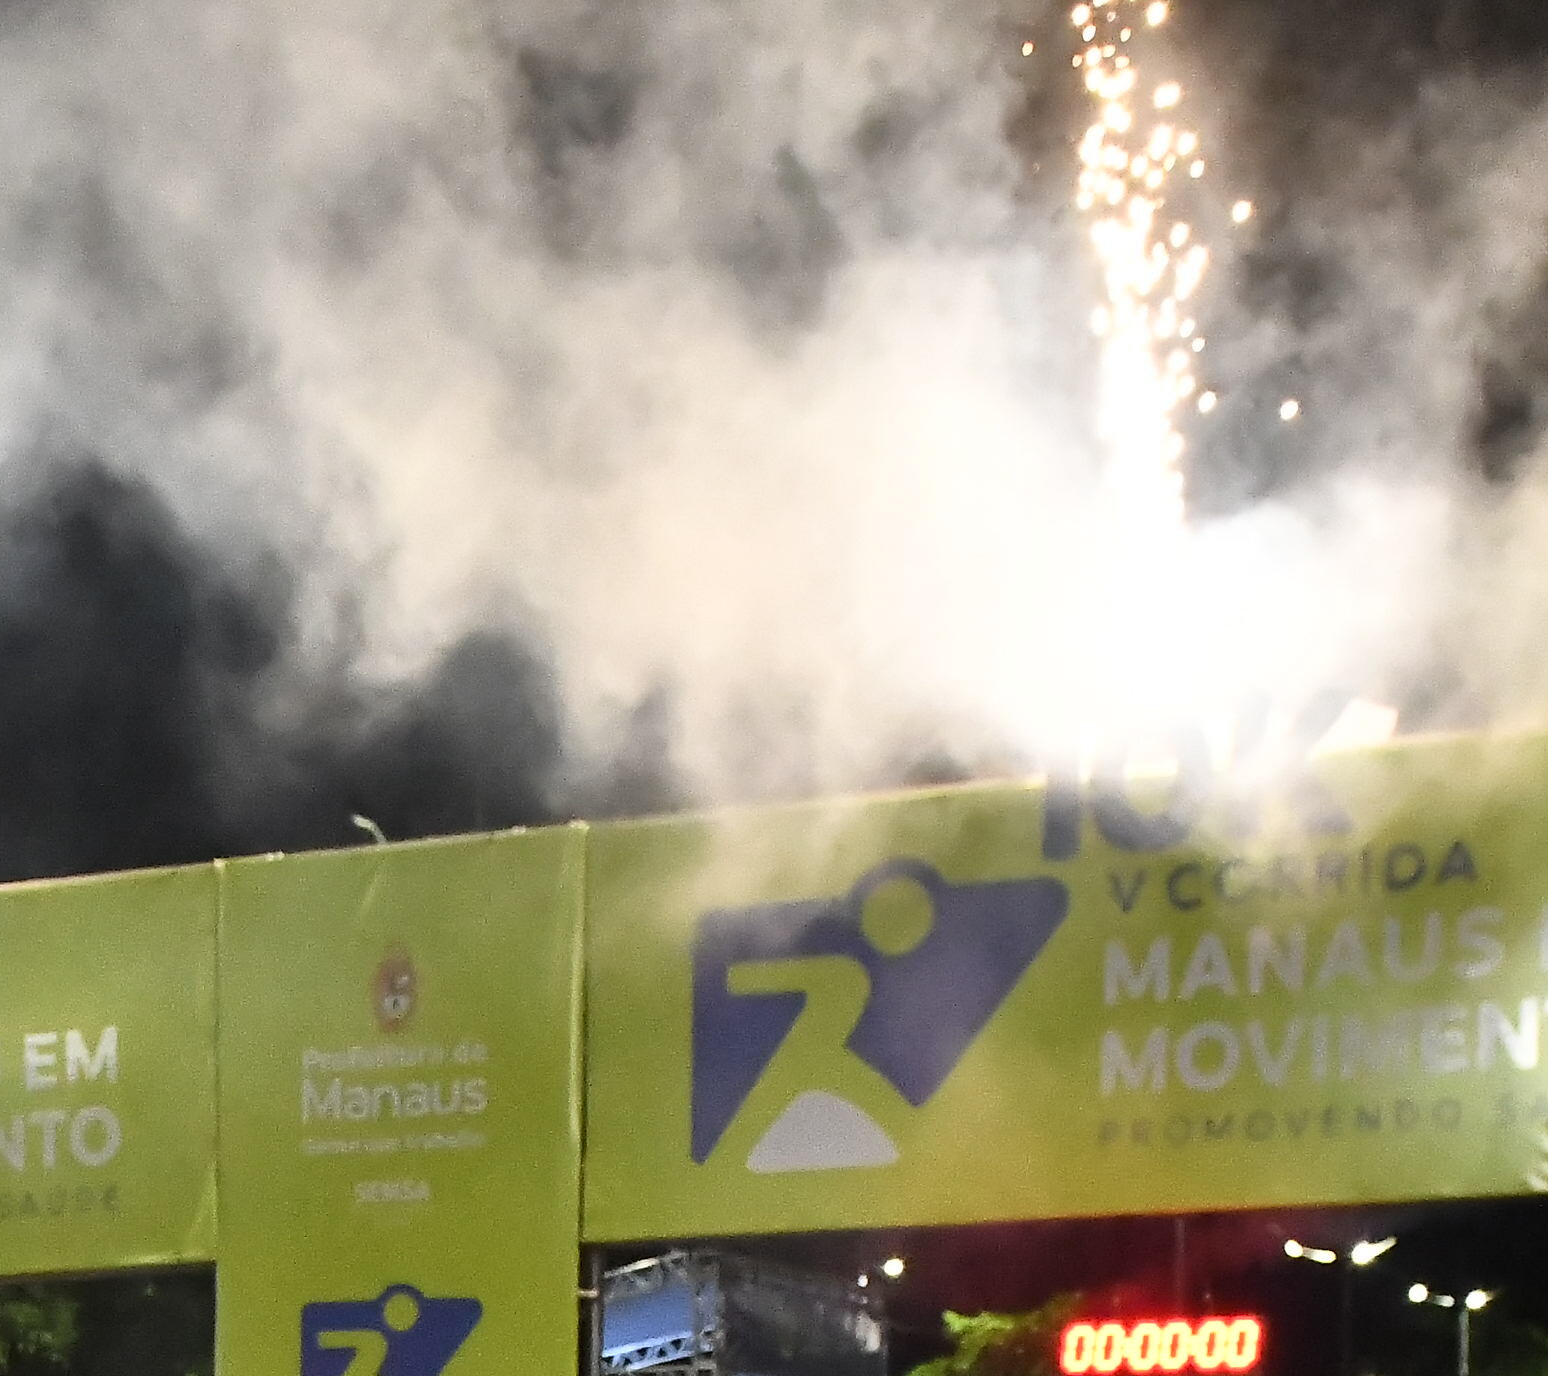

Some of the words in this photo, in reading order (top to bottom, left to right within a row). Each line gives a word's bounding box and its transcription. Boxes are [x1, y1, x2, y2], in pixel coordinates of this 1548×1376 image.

[1166, 841, 1477, 910] CORRIDA
[1104, 906, 1506, 1005] MANAUS
[23, 1026, 121, 1092] EM
[303, 1077, 489, 1123] Manaus
[1098, 1102, 1464, 1147] PROMOVENDO
[1062, 1317, 1261, 1374] 00:00:00
